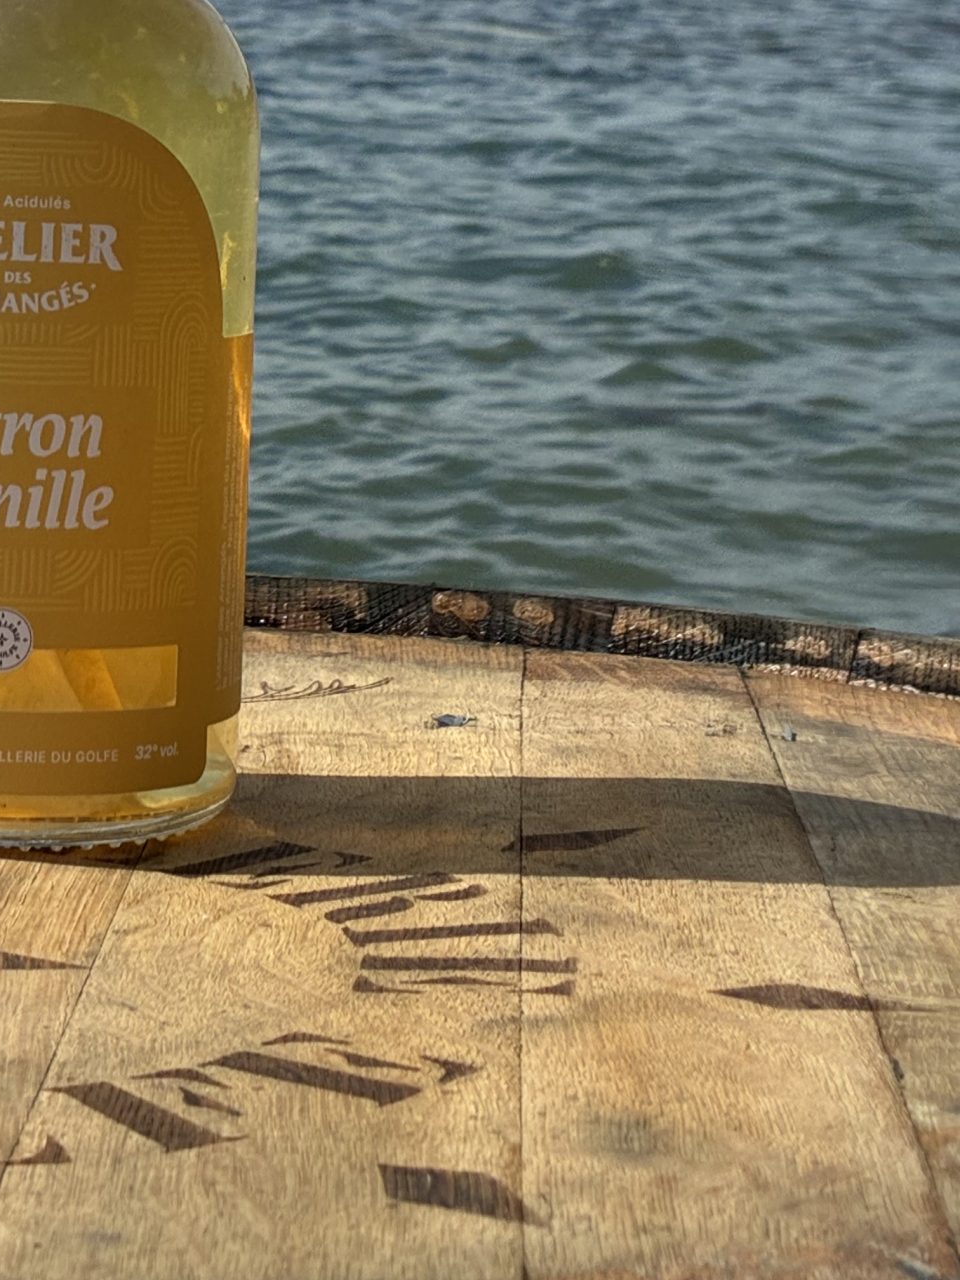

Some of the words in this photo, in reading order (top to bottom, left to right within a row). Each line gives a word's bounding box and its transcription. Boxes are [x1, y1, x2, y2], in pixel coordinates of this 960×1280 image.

[4, 193, 72, 210] Acidulés
[4, 271, 32, 284] DES
[51, 749, 72, 764] DU
[75, 749, 119, 765] GOLFE
